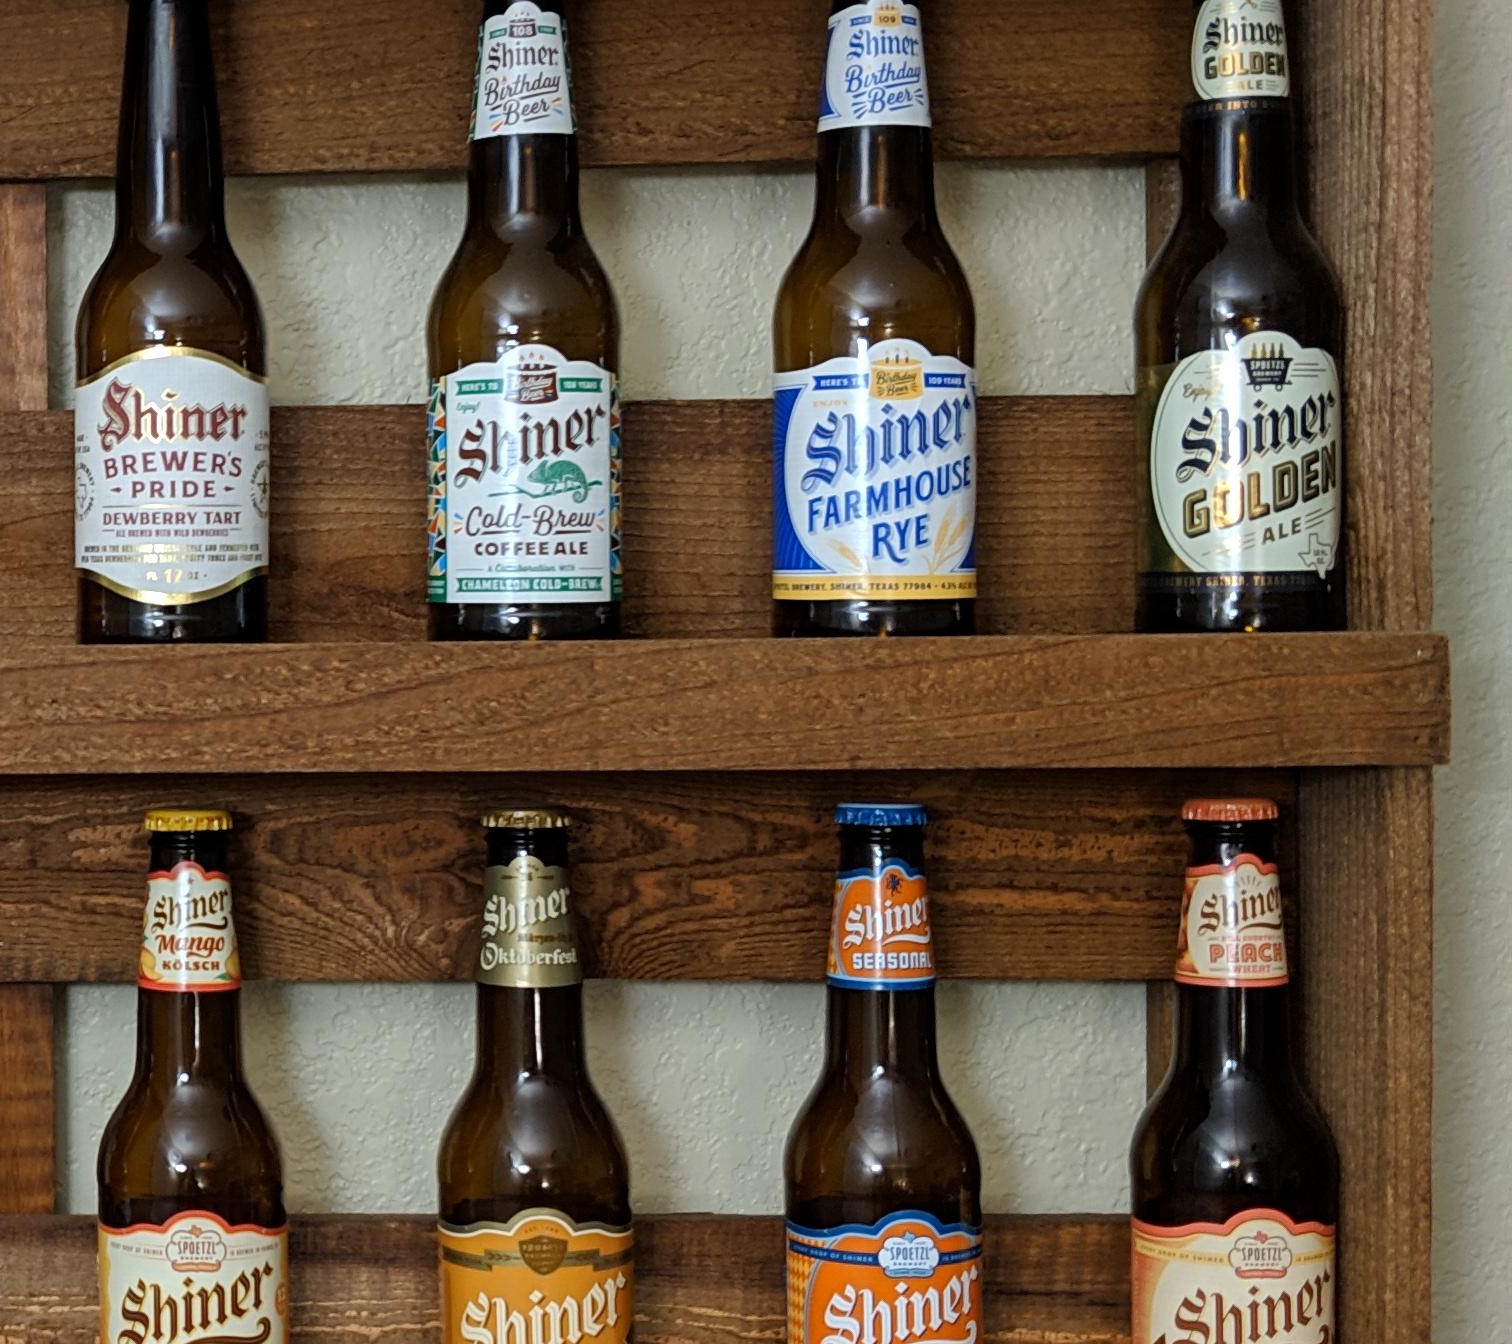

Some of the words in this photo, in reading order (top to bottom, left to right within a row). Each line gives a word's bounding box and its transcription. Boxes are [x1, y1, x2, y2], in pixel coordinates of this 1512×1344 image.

[513, 27, 532, 35] 108
[484, 72, 561, 106] Birthday
[845, 62, 920, 93] Birthday
[98, 377, 247, 451] Shiner
[801, 395, 970, 492] Shiner
[1176, 391, 1335, 483] Shiner
[103, 451, 242, 479] BREWER'S
[131, 481, 216, 498] PRIDE
[808, 455, 971, 533] FARMHOUSE
[1183, 440, 1336, 538] GOLDEN
[103, 512, 197, 525] DEWBERRY
[204, 512, 241, 524] TART
[466, 504, 595, 536] Cold-Brew
[1262, 517, 1302, 545] ALE
[474, 542, 549, 555] COFFEE
[555, 542, 588, 555] ALE
[872, 513, 930, 565] RYE
[162, 959, 219, 970] KÖLSCH
[852, 951, 932, 969] SEASONAL
[177, 1242, 216, 1255] SPOETZL
[889, 1245, 930, 1261] SPOETZL
[1241, 1246, 1282, 1261] SPOETZL
